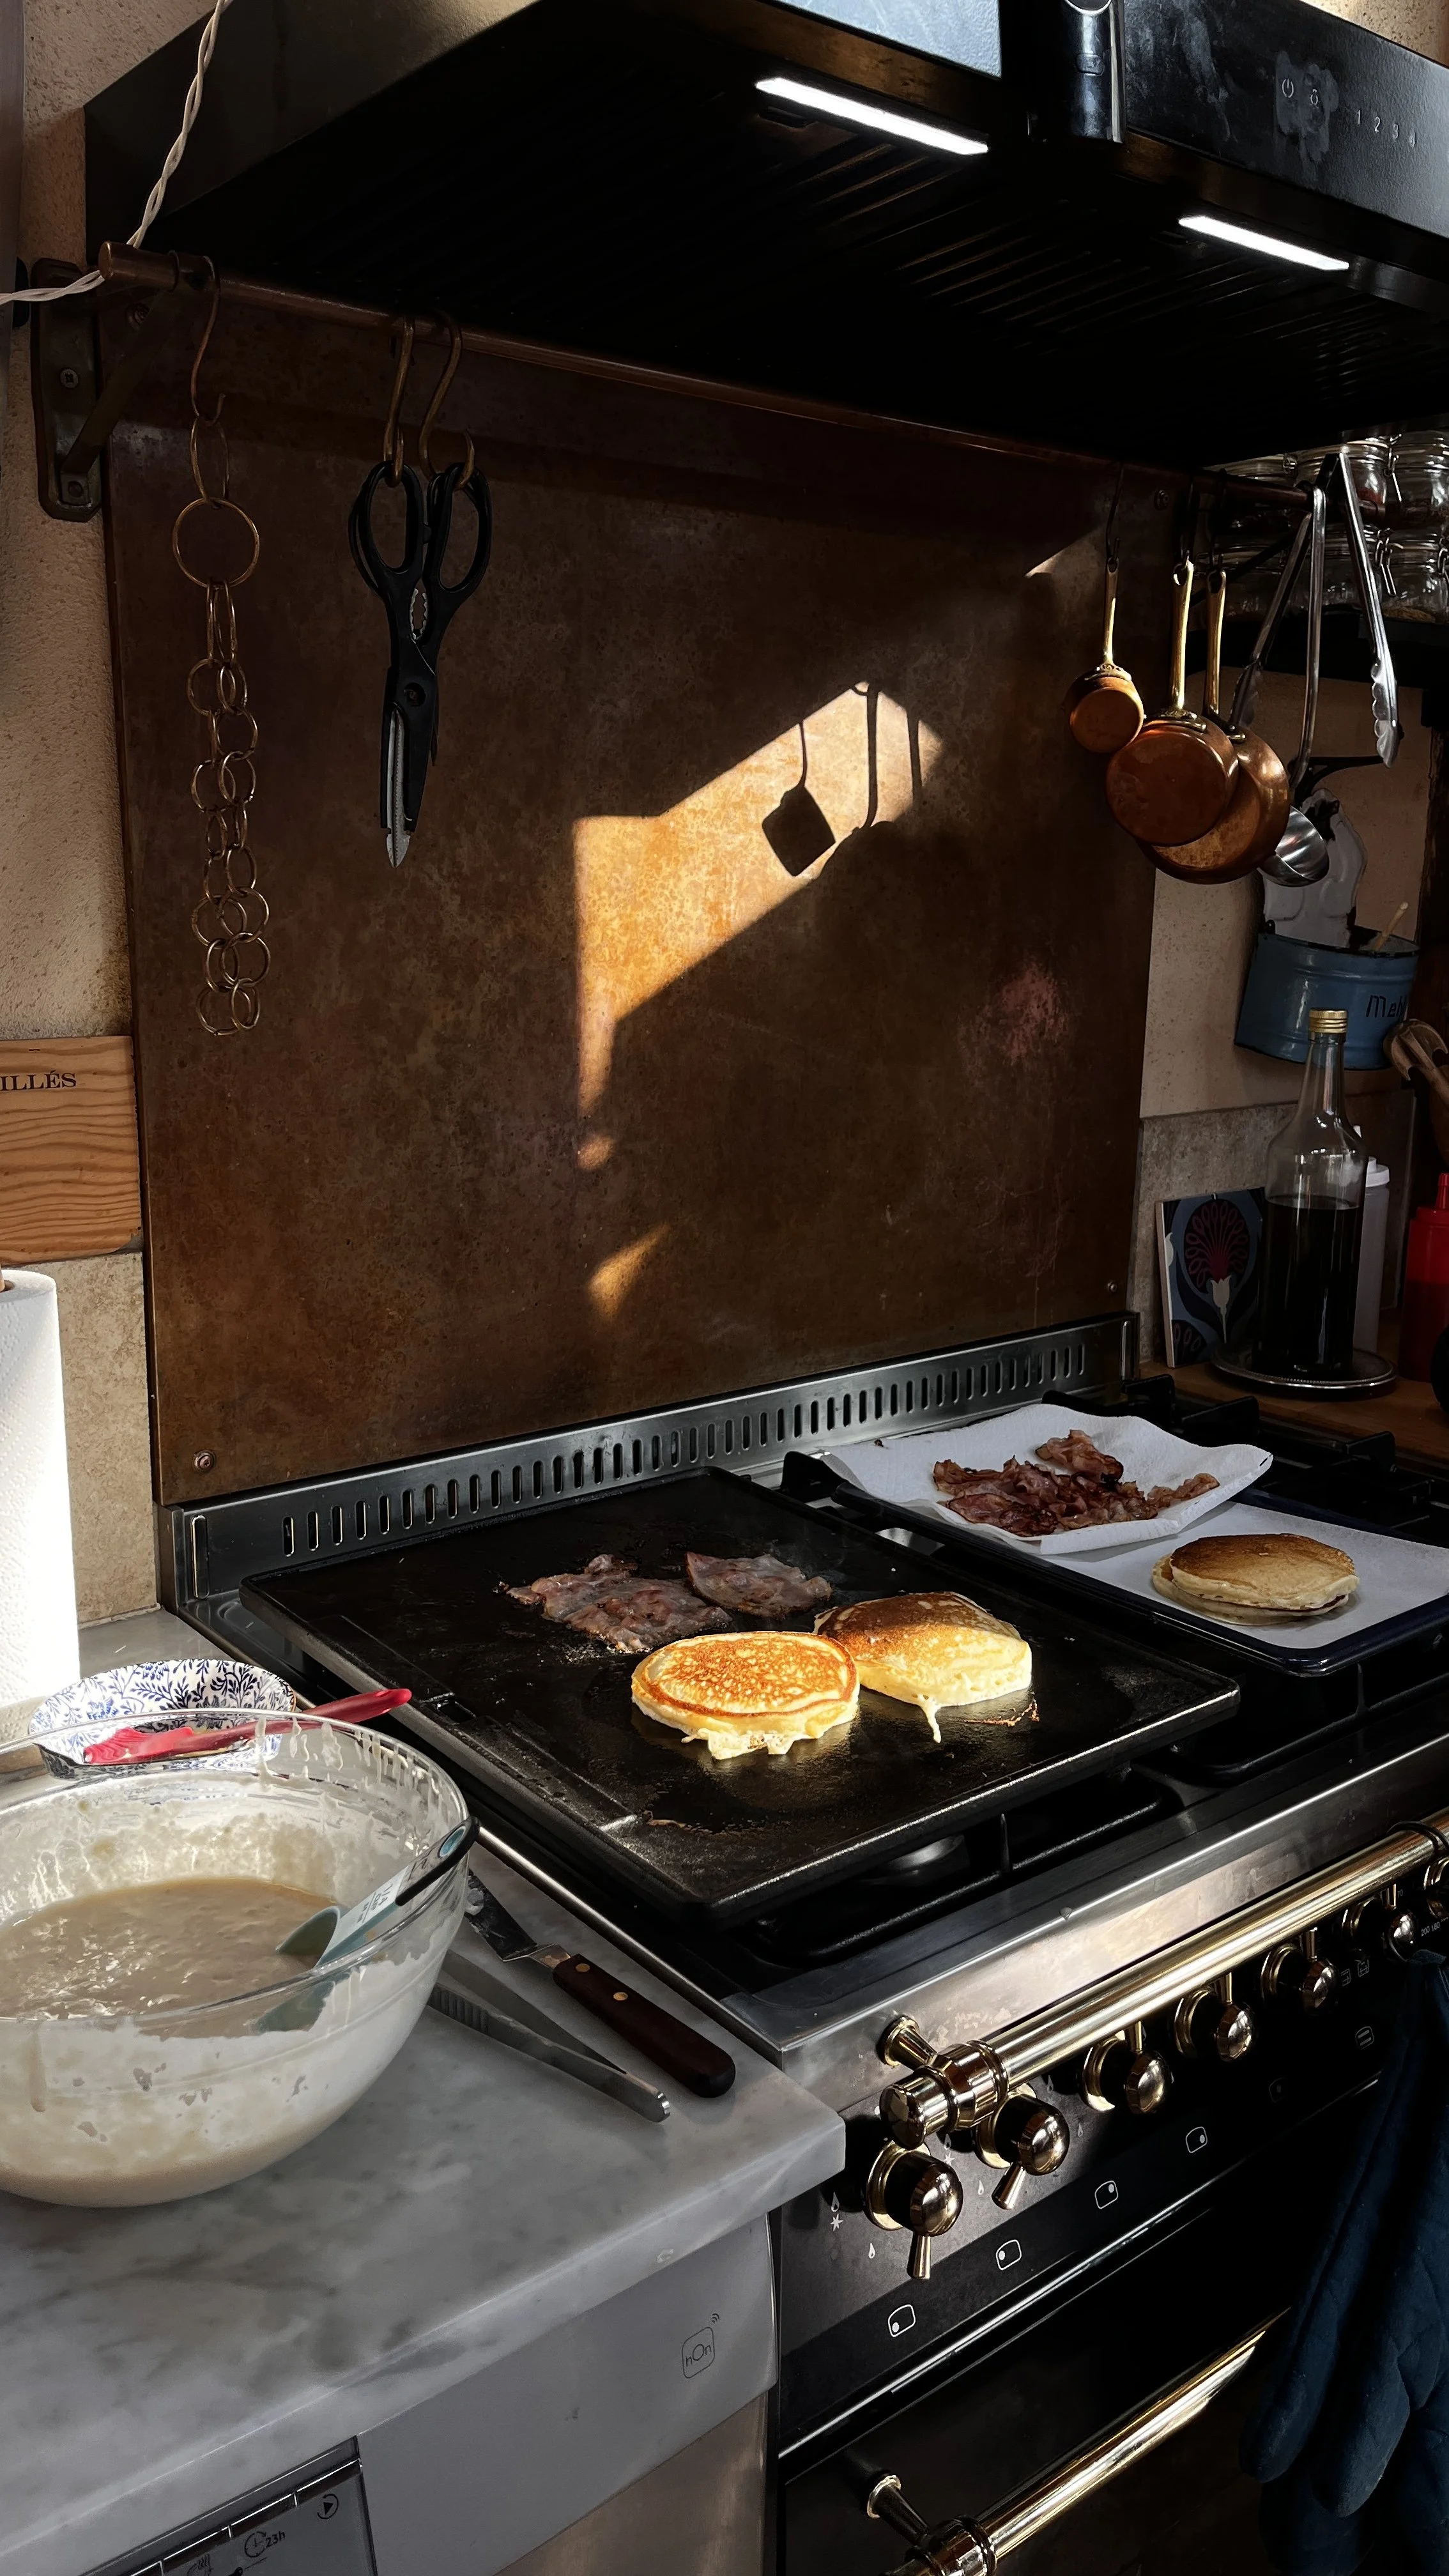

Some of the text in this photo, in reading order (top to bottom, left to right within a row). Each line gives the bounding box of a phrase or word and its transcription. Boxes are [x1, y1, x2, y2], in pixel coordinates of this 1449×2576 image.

[1356, 109, 1361, 125] 1
[1374, 116, 1381, 133] 2
[1392, 123, 1399, 139] 3
[1420, 1926, 1430, 1937] 200
[265, 2530, 286, 2549] 23h
